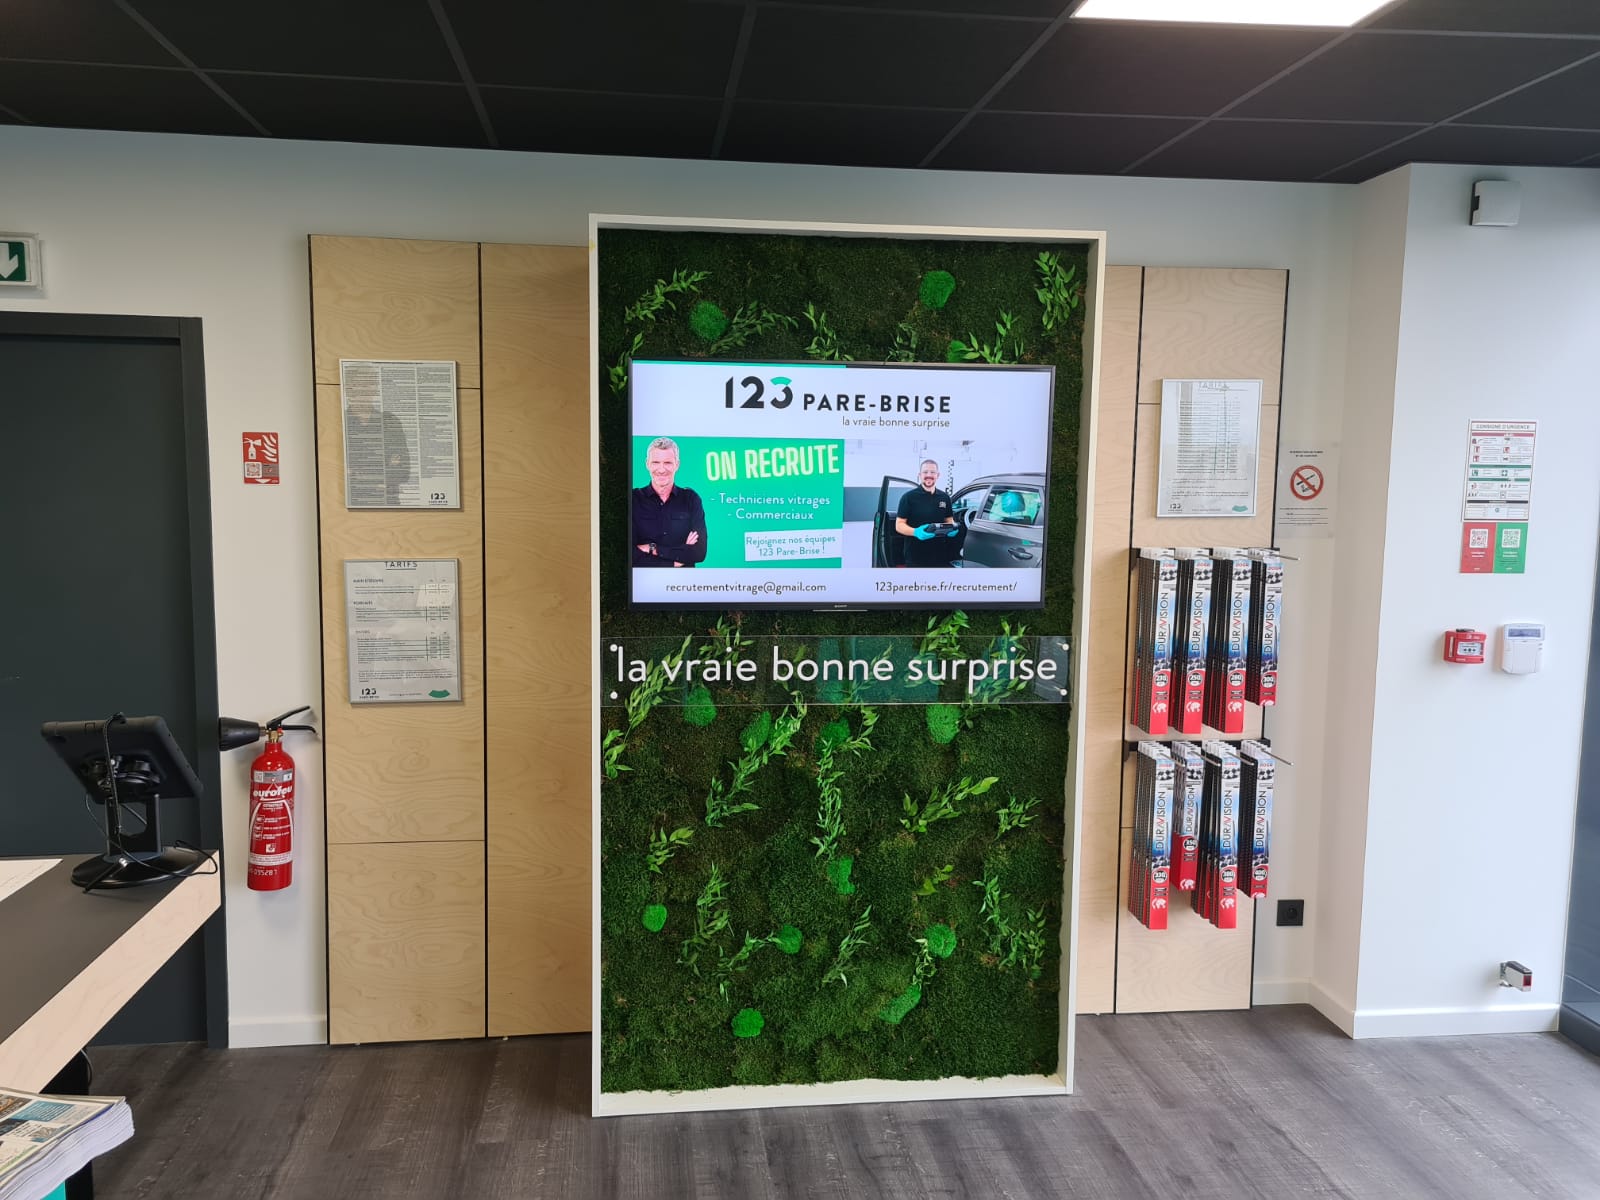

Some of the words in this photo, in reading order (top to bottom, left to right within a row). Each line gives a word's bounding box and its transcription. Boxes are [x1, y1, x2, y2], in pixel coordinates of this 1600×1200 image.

[725, 376, 793, 409] 123
[803, 393, 951, 413] PARE-BRISE
[842, 416, 850, 426] la
[853, 416, 876, 427] vraie
[879, 416, 910, 427] bonne
[912, 417, 950, 430] surprise
[705, 450, 737, 481] ON
[744, 444, 840, 479] RECRUTE
[719, 492, 785, 505] Techniciens
[788, 493, 831, 509] vitrages
[735, 508, 814, 520] Commerciaux
[746, 536, 786, 548] Rejoignez
[804, 534, 836, 546] équipes
[758, 548, 774, 557] 123
[665, 581, 827, 596] recrutementvitrage@gmail.com
[875, 581, 1017, 594] 123parebrise.fr/recrutement/
[617, 646, 647, 682] la
[661, 646, 757, 682] vraie
[772, 645, 894, 682] bonne
[907, 646, 1057, 695] surprise
[253, 785, 292, 797] eurofeu
